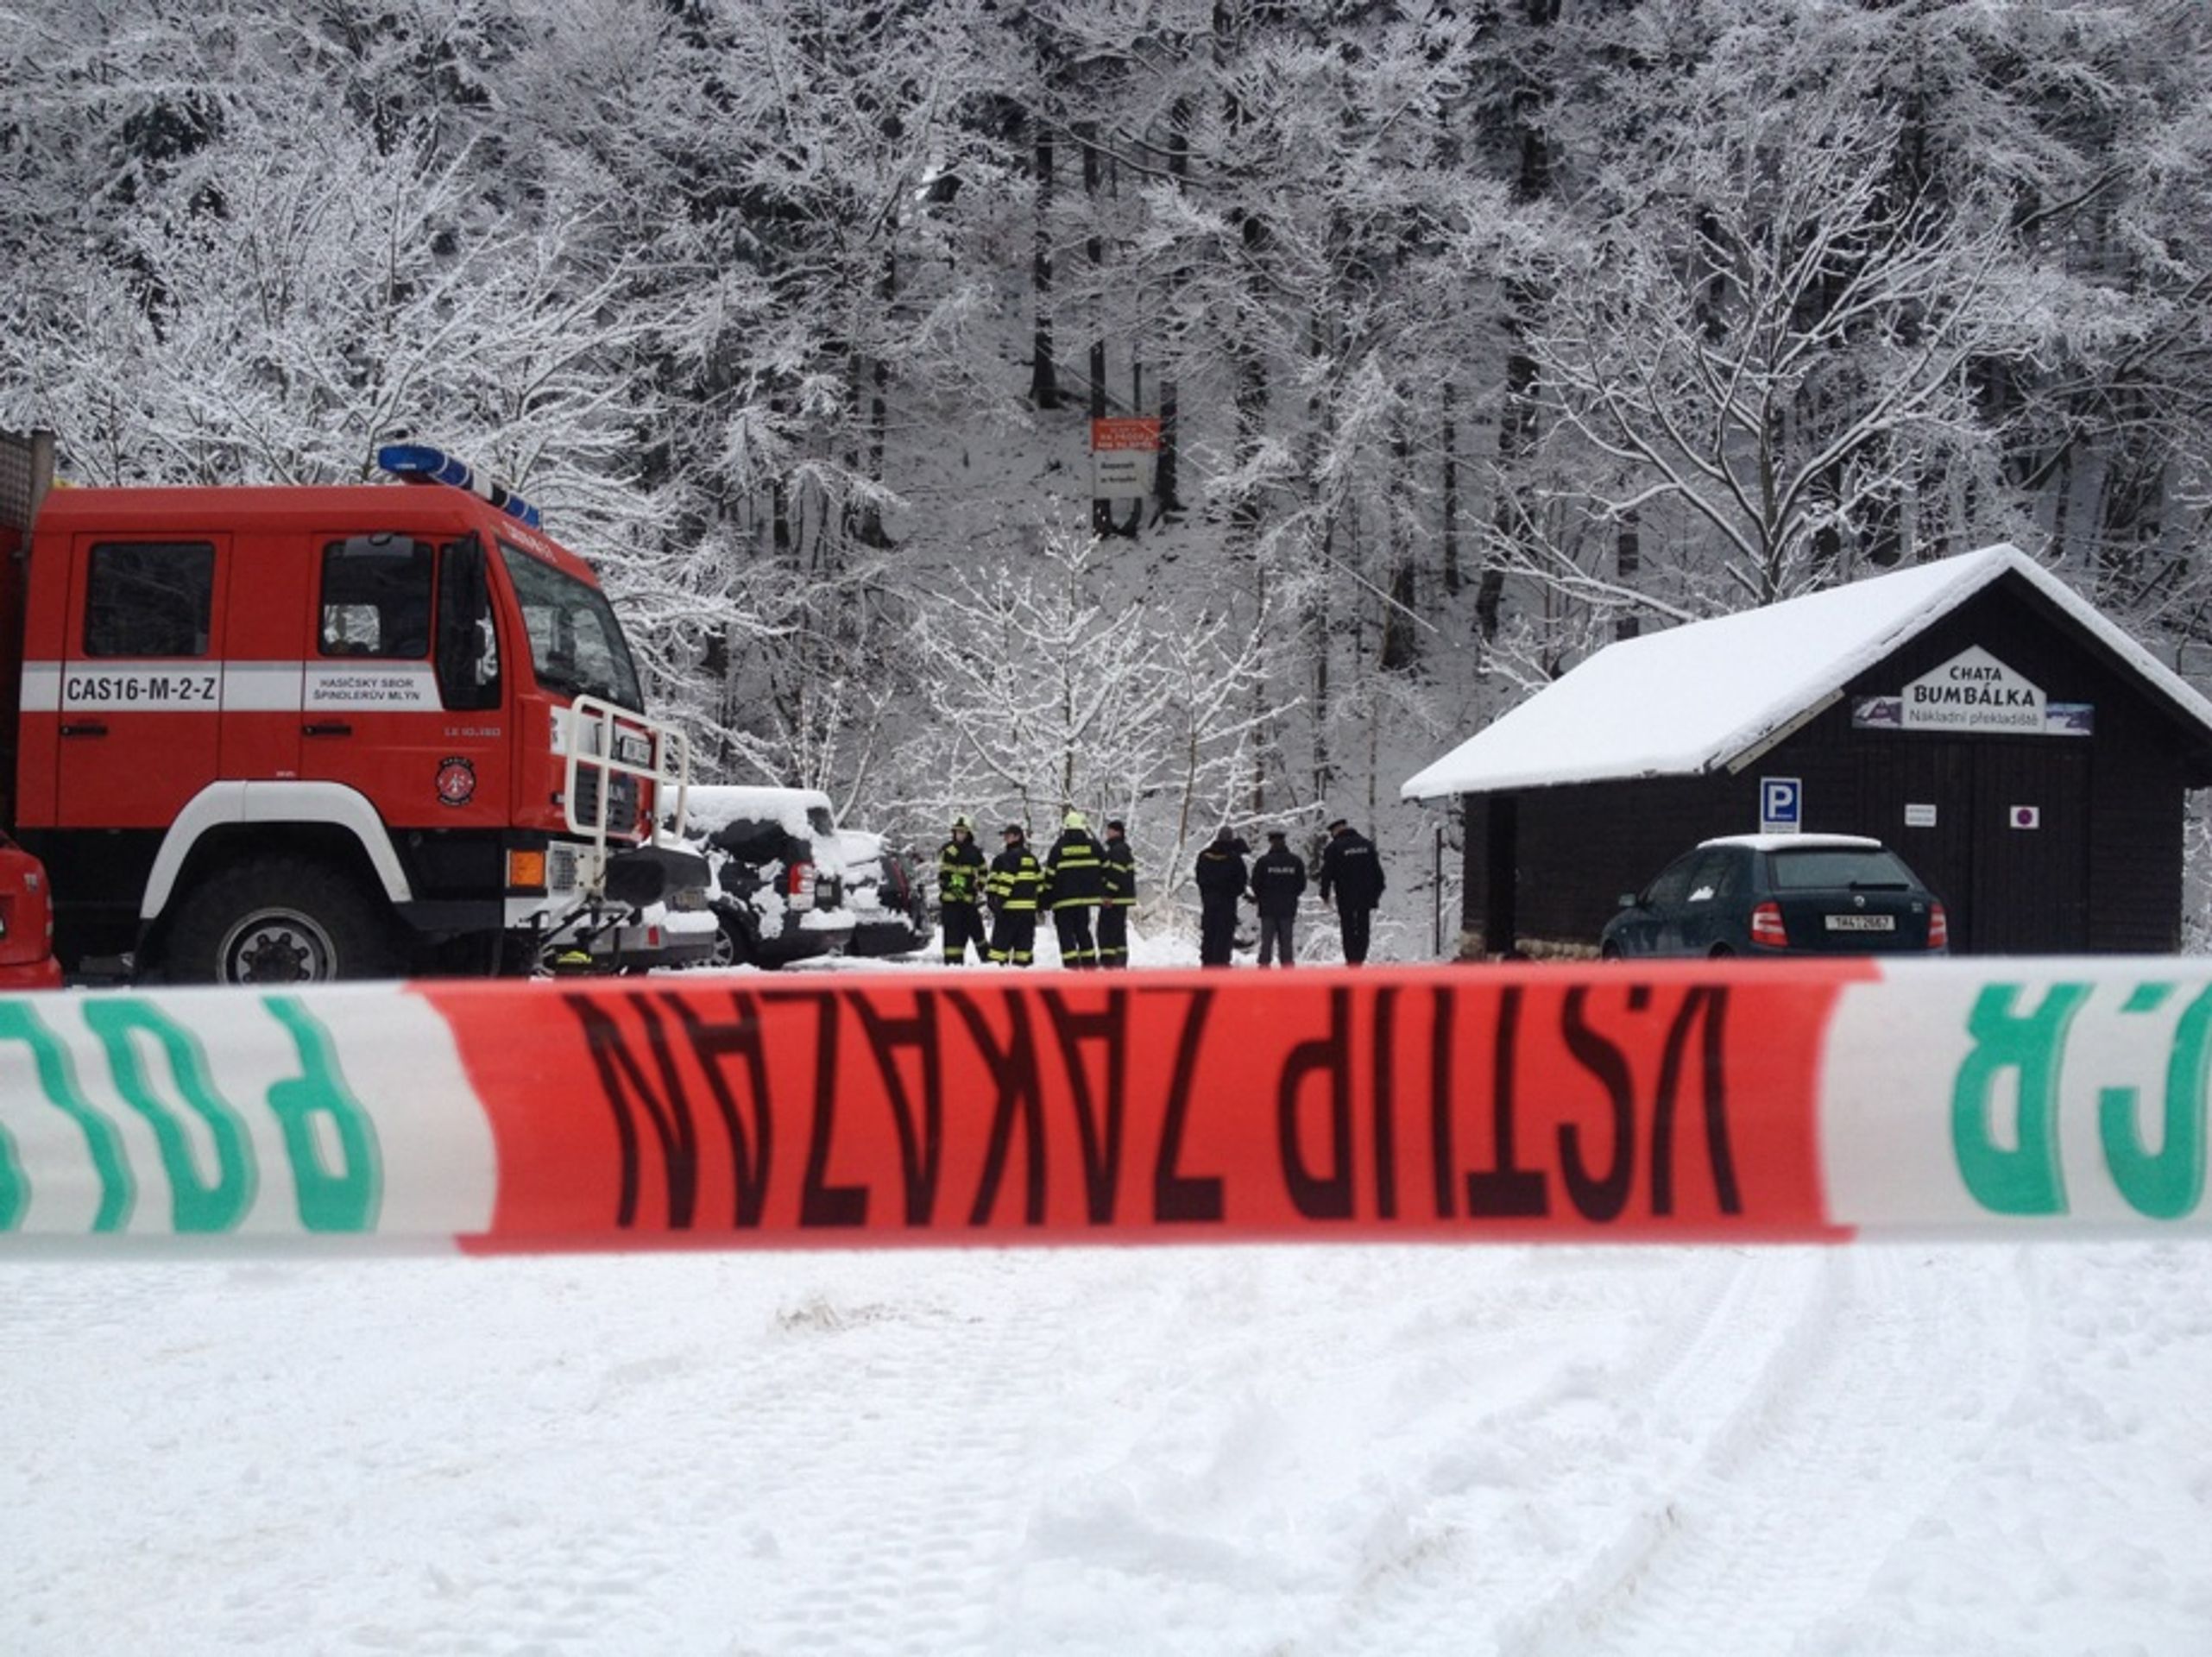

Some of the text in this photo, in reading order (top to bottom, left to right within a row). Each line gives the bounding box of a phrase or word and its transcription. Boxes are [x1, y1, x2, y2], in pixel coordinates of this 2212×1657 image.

[381, 678, 414, 688] SBOR
[1950, 665, 2002, 681] CHATA
[67, 677, 215, 701] CAS16-M-2-Z
[1913, 682, 2035, 708] BUMBÁLKA
[1768, 784, 1793, 819] P
[561, 984, 1743, 1231] VSTUP ZAKAZAN
